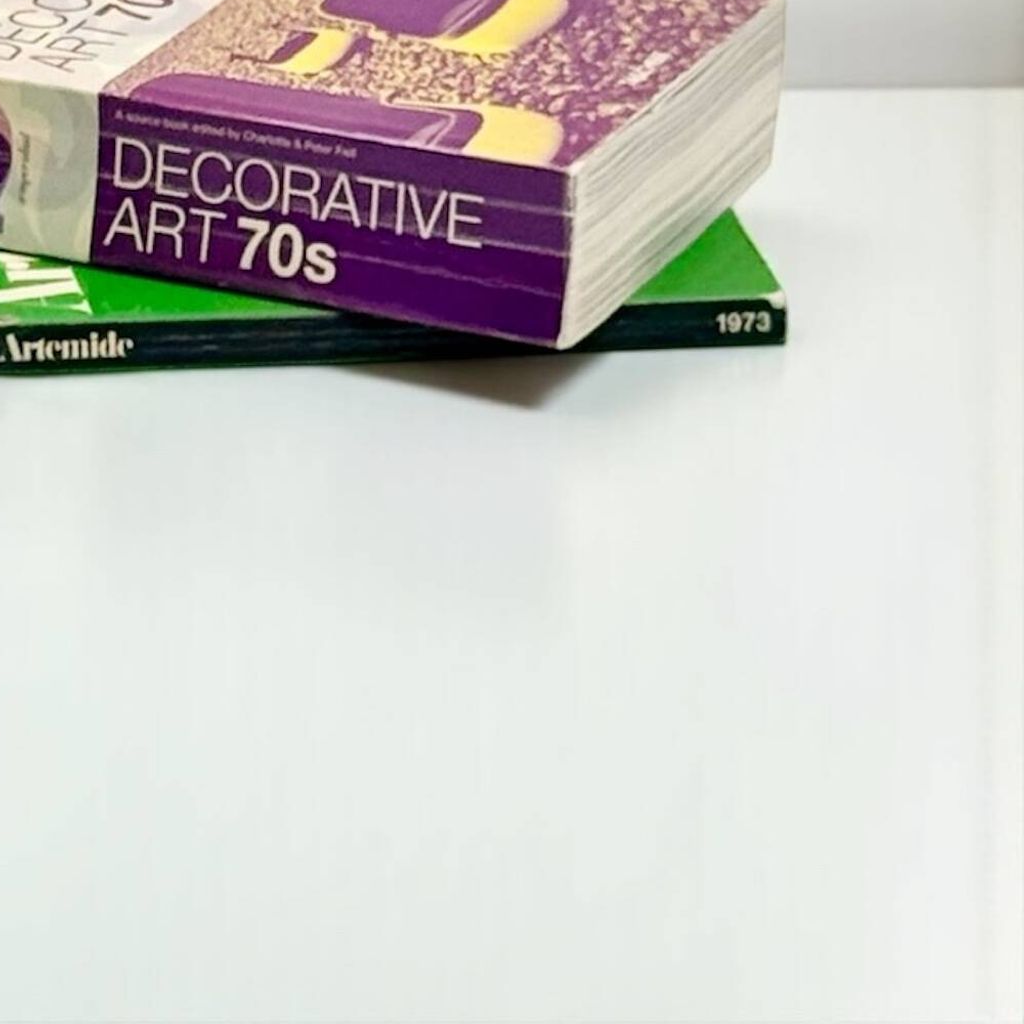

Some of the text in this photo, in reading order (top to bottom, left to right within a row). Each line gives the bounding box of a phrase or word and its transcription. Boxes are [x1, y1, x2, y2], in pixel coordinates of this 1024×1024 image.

[30, 19, 129, 73] ART
[192, 122, 225, 137] edited
[227, 126, 241, 141] by
[304, 140, 333, 154] Peter
[113, 136, 485, 249] DECORATIVE
[103, 197, 338, 285] ART 70s
[716, 311, 771, 333] 1973
